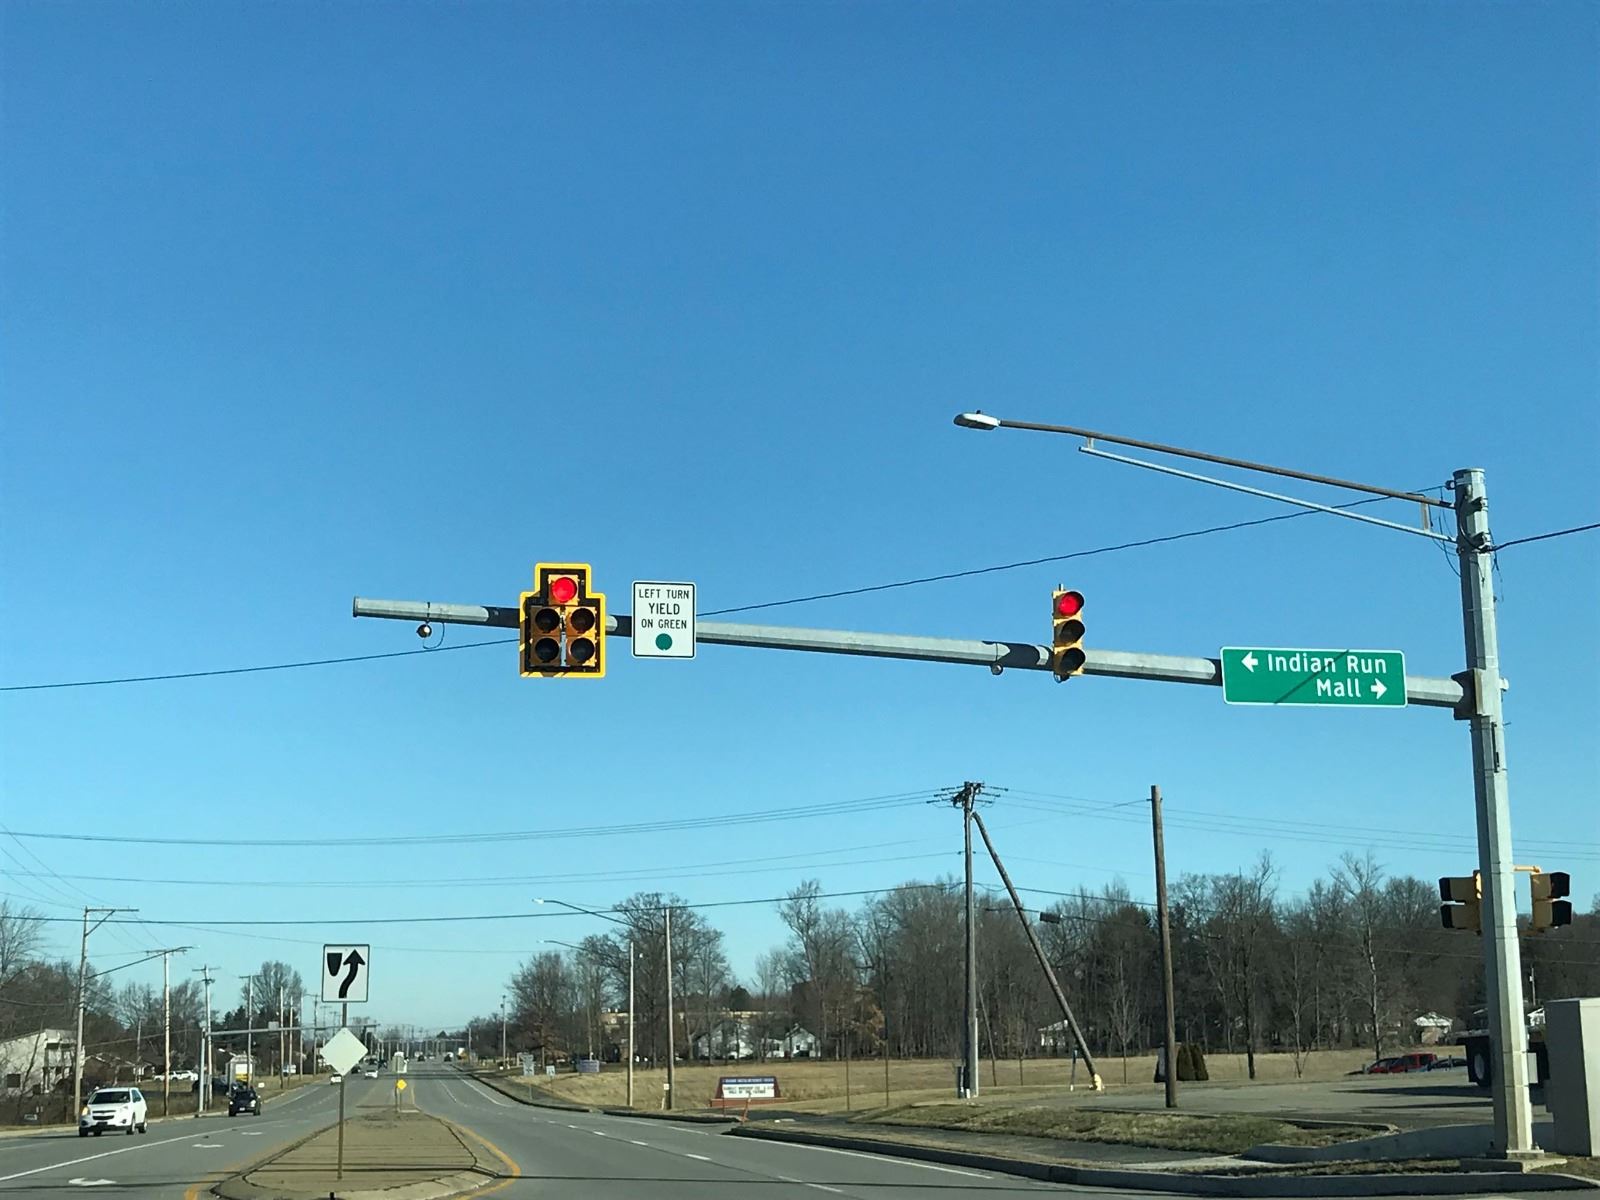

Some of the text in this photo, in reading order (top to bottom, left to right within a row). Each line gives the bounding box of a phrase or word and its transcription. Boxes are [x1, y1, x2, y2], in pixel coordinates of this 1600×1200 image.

[638, 588, 690, 599] LEFT TURN
[648, 602, 681, 615] YIELD
[641, 618, 687, 629] ON GREEN
[1267, 652, 1387, 674] Indian Run
[1316, 678, 1361, 698] Mall
